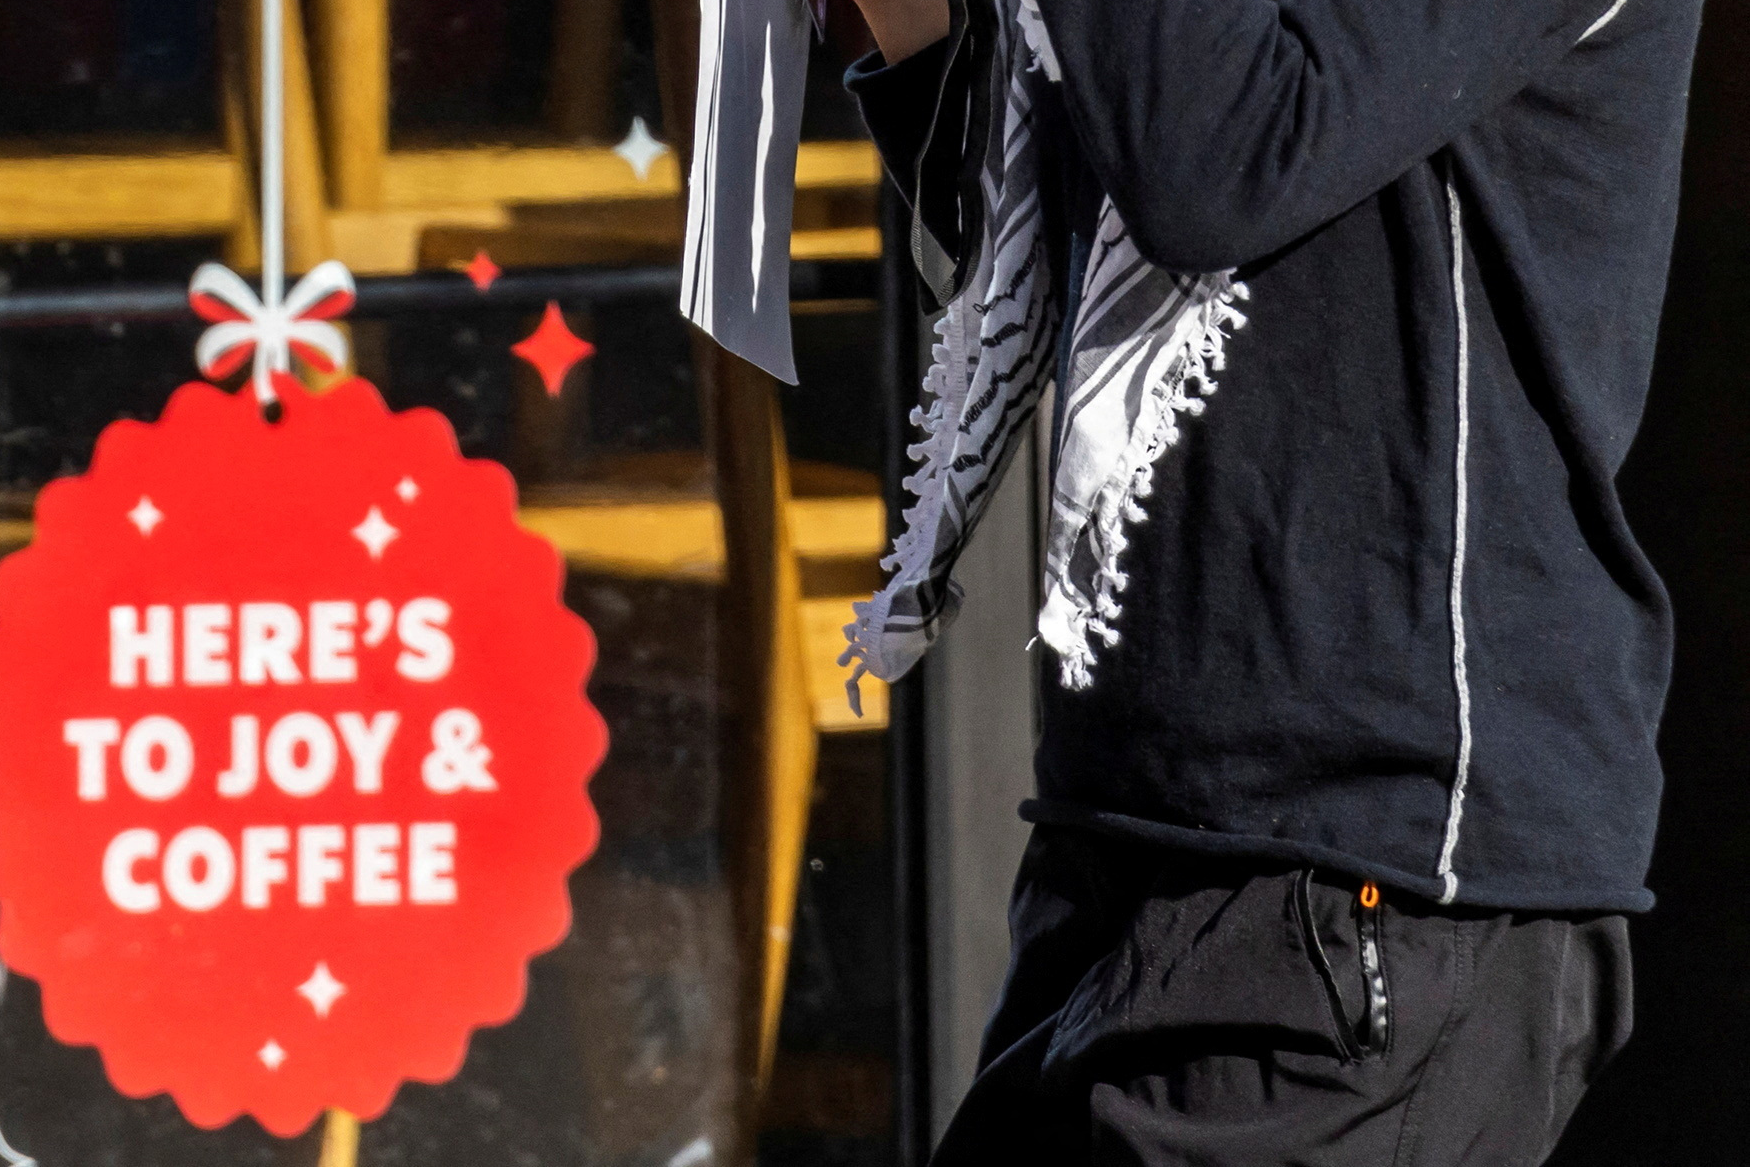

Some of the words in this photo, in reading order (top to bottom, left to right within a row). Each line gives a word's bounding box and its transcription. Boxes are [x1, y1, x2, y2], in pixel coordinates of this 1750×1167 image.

[108, 598, 456, 688] HERE’S
[63, 715, 195, 801] TO
[216, 710, 400, 799] JOY
[421, 709, 498, 794] &
[101, 822, 459, 913] COFFEE
